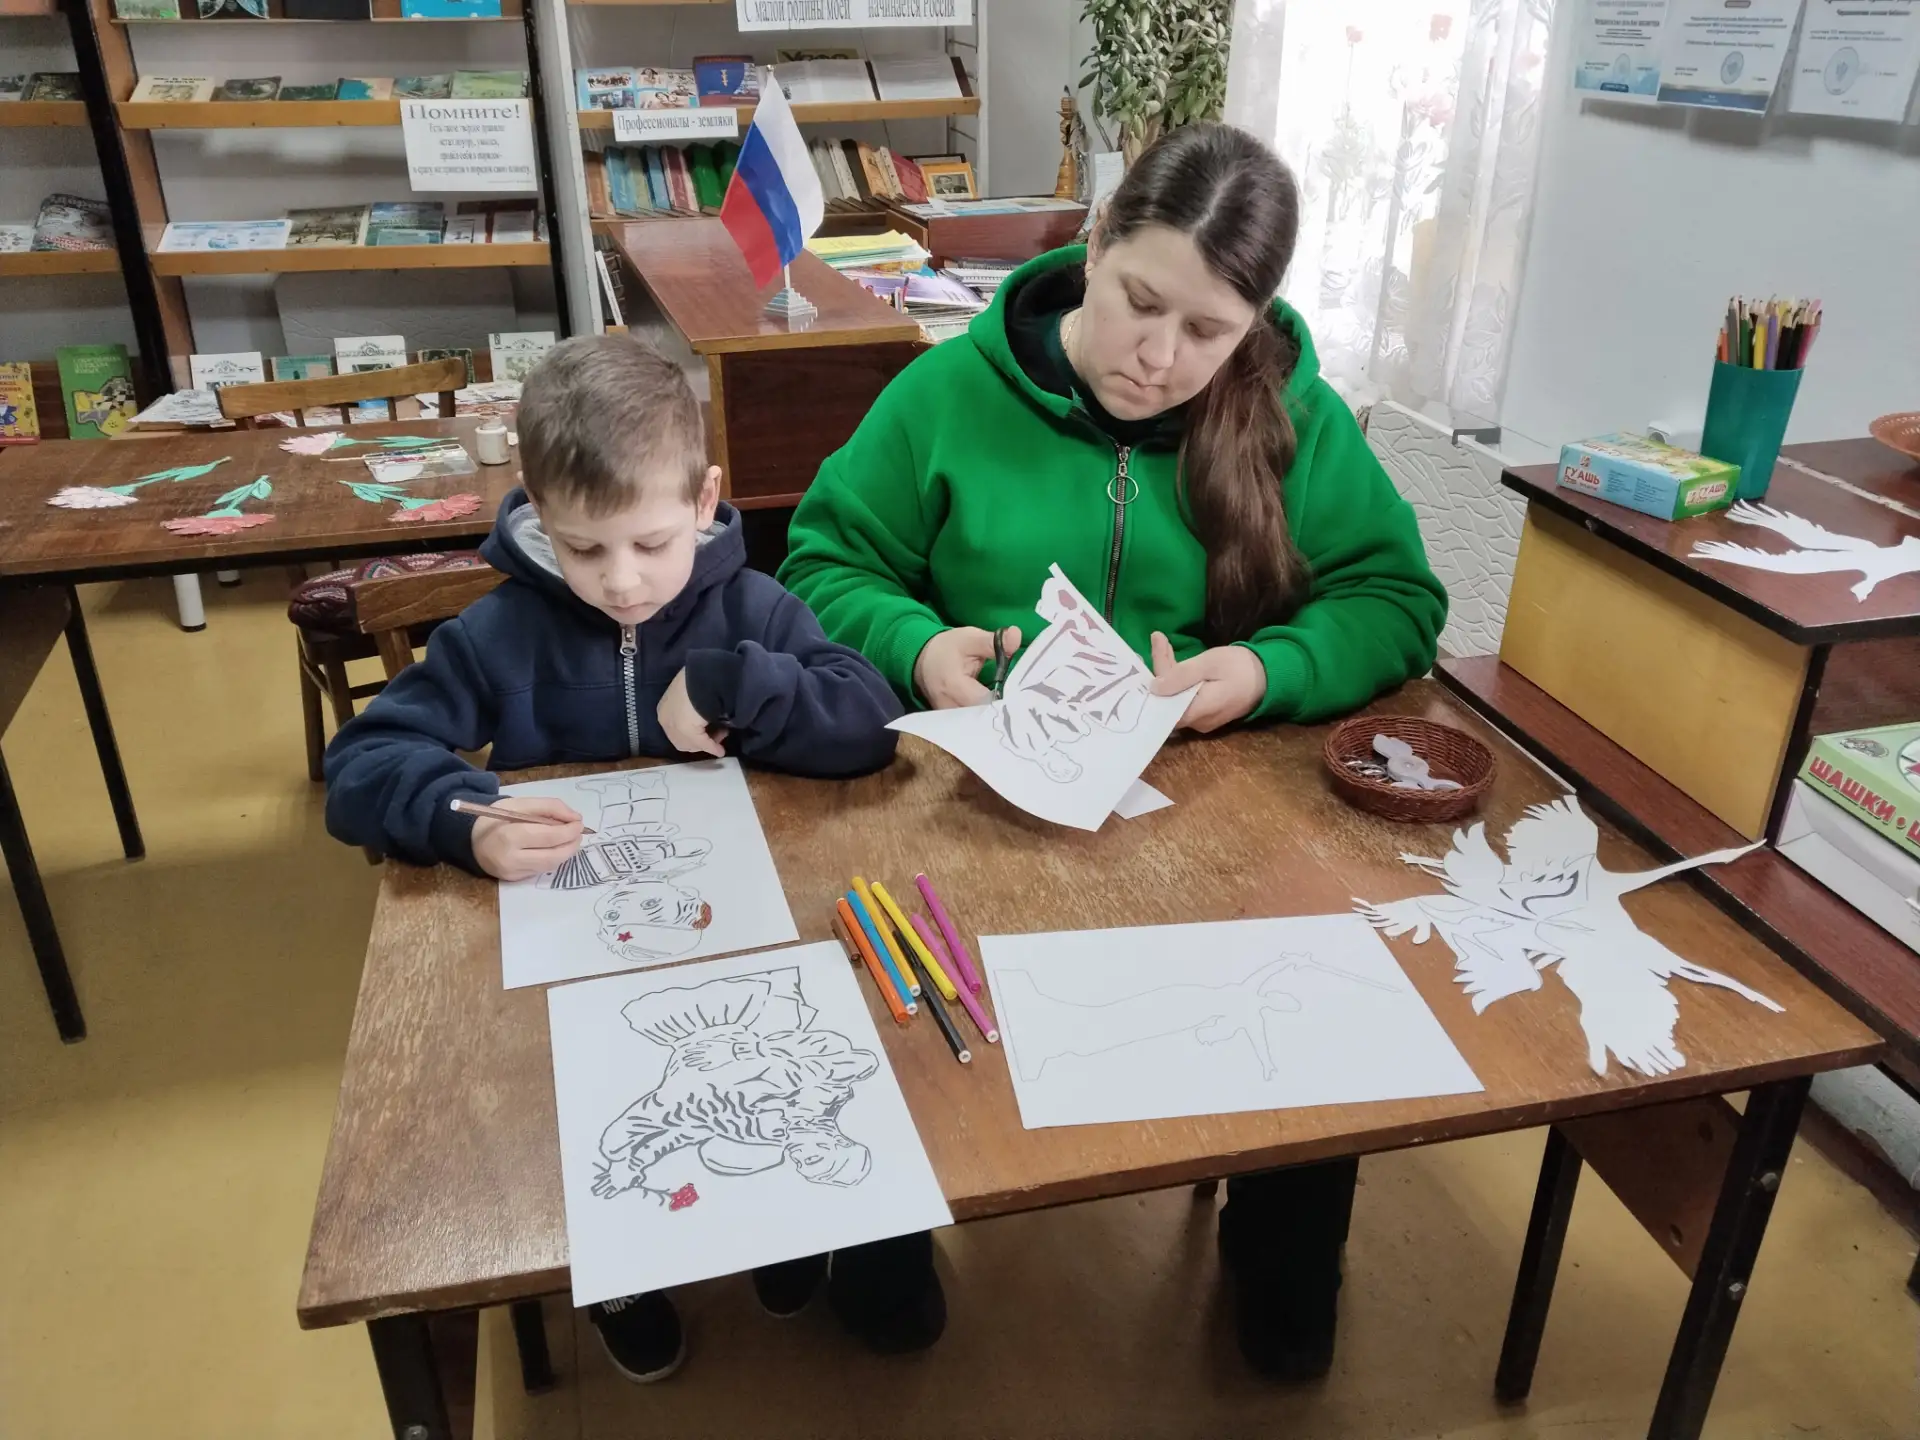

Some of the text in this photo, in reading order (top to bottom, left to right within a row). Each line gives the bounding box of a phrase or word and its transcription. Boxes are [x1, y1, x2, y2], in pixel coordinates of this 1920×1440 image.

[788, 0, 825, 23] родины
[409, 104, 520, 119] Помните!
[617, 114, 690, 134] Профессионалы
[697, 115, 734, 128] земляки
[1564, 466, 1600, 484] ГУАШЬ
[1700, 483, 1727, 494] ГУАШЬ
[1808, 756, 1897, 825] ШАШКИ
